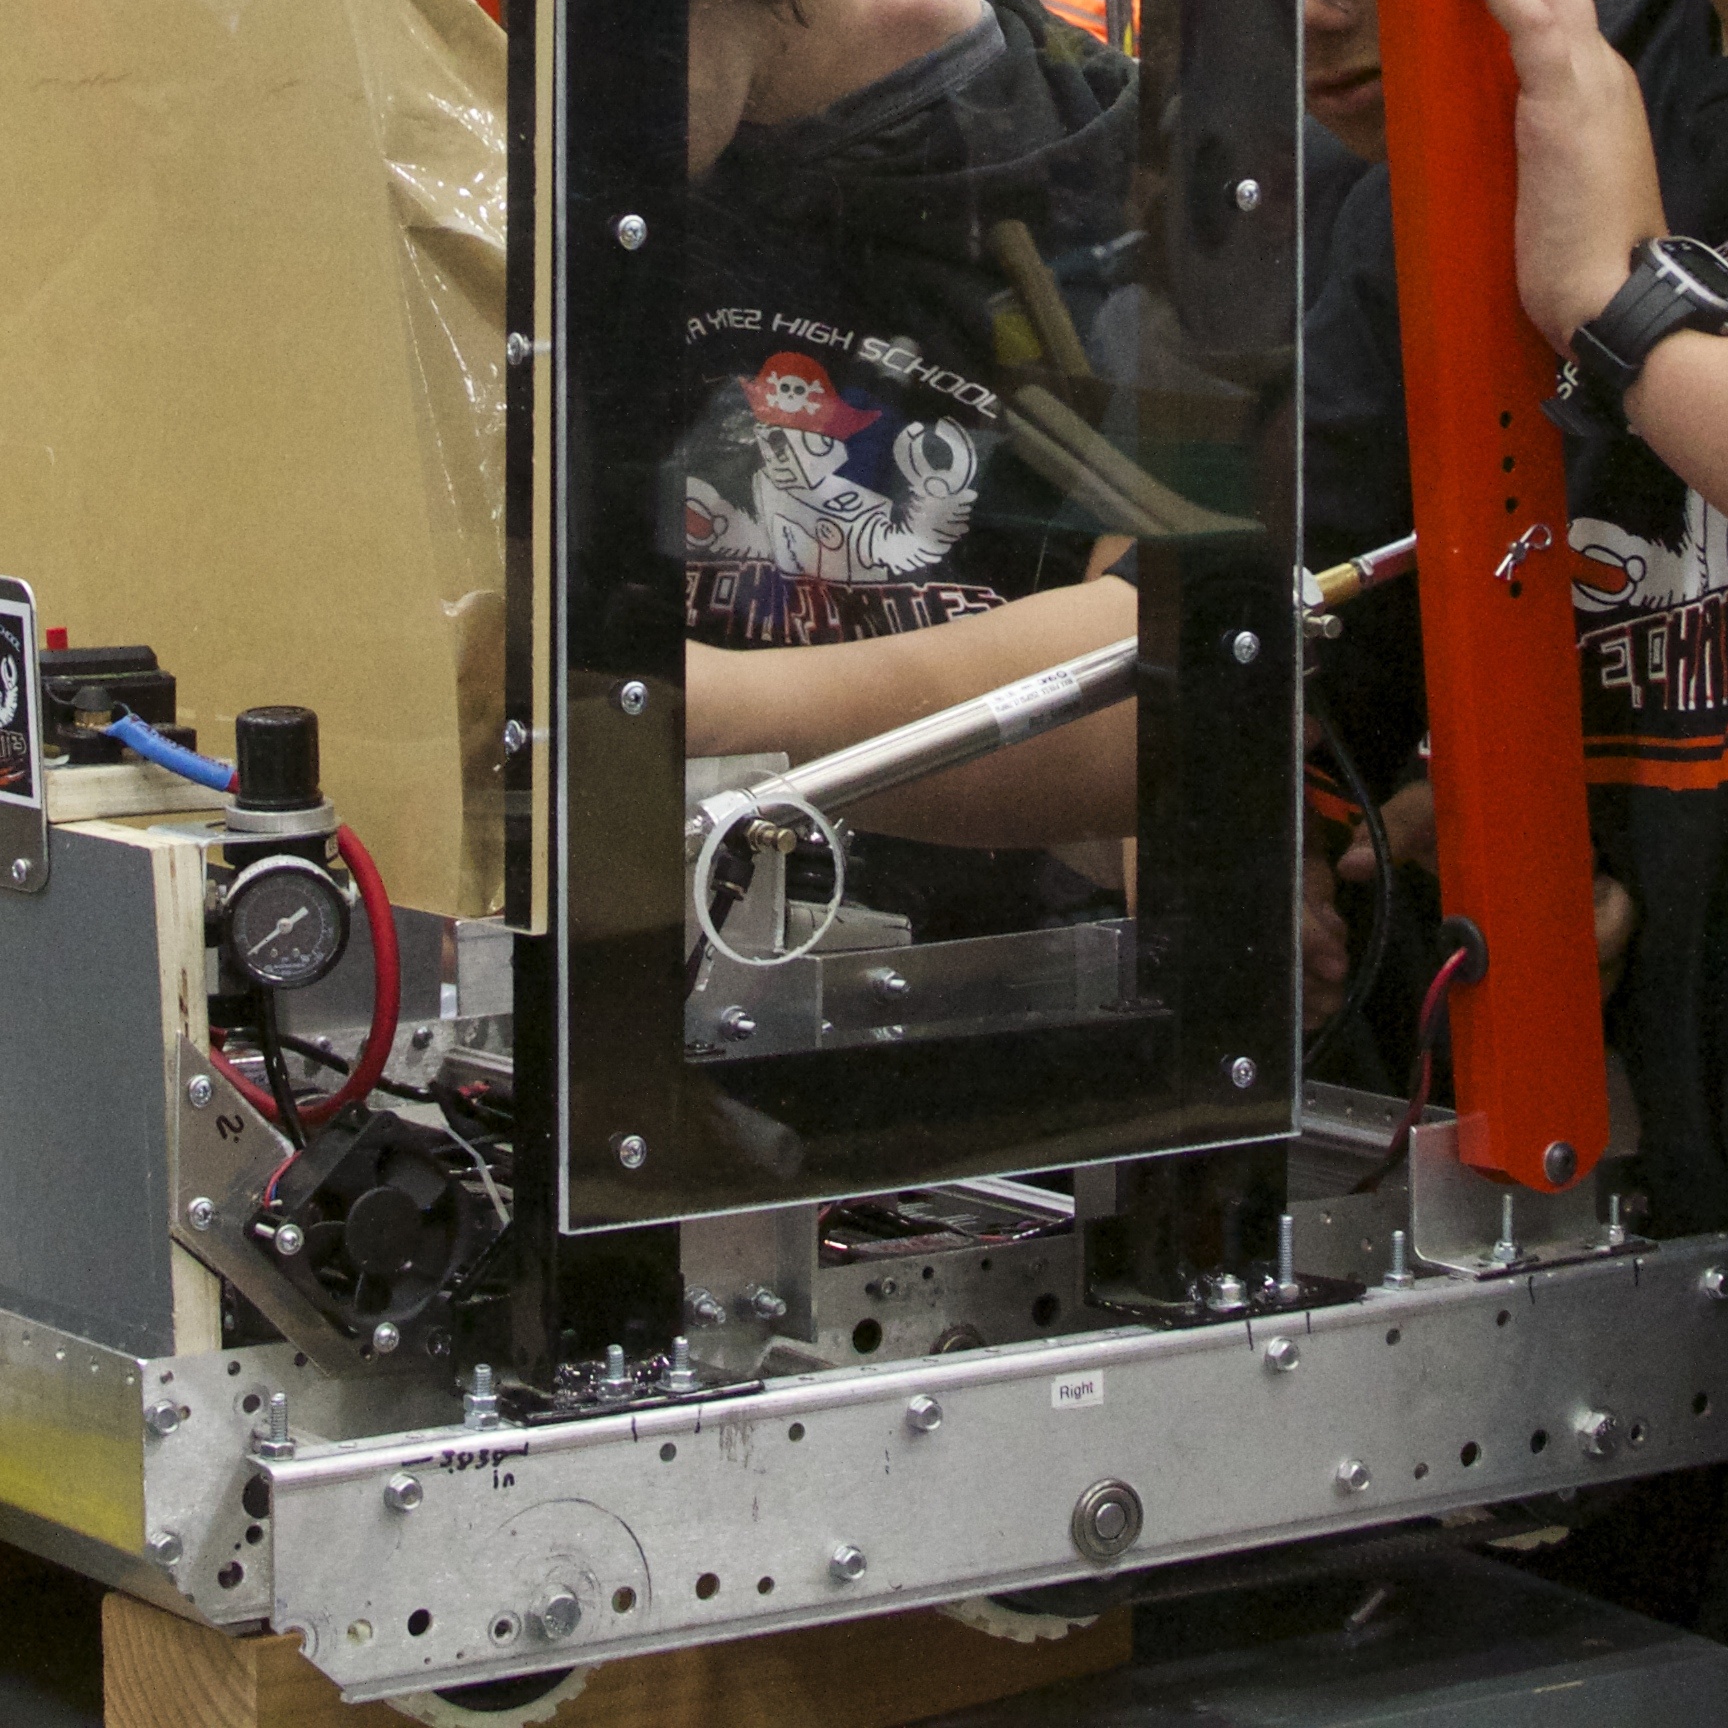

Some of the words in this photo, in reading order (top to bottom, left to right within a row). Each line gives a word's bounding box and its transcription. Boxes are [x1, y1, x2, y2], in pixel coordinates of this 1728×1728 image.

[771, 313, 855, 351] HIGH
[857, 337, 998, 419] SCHOOL
[1059, 1381, 1094, 1400] Right
[492, 1469, 516, 1489] in
